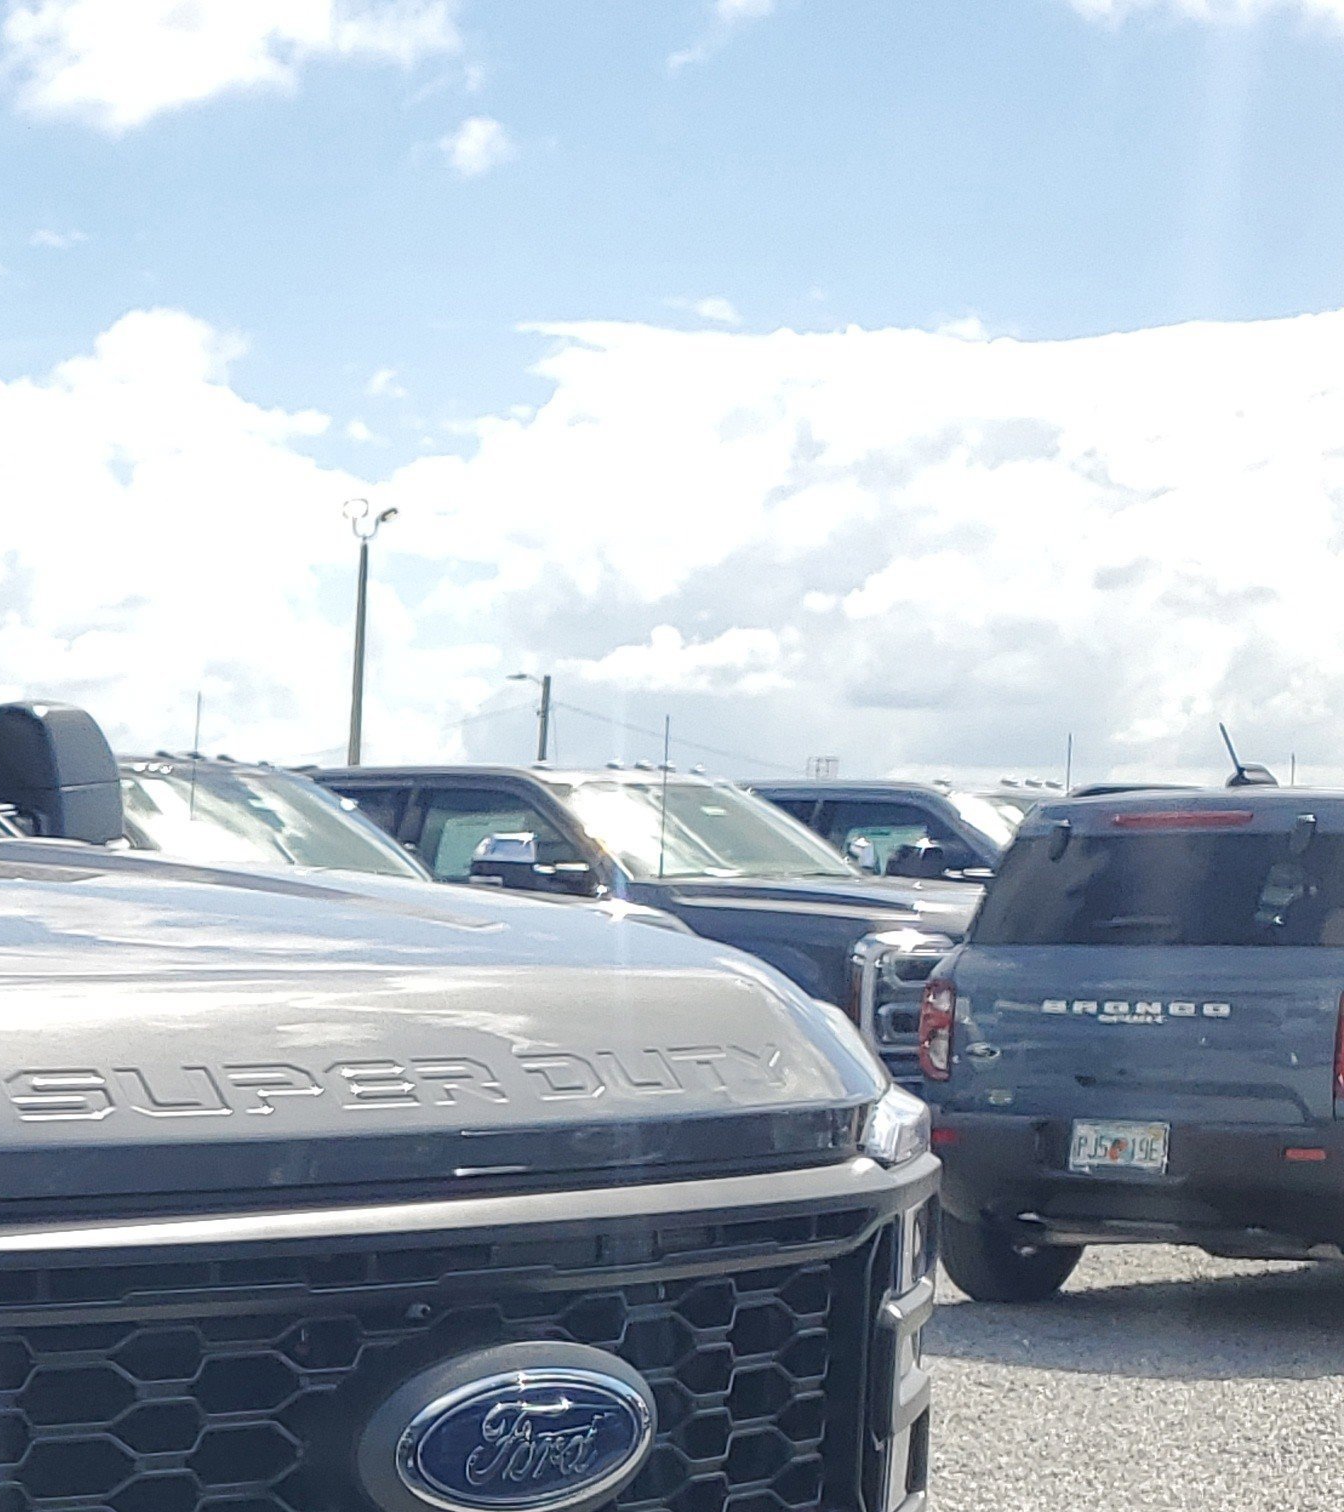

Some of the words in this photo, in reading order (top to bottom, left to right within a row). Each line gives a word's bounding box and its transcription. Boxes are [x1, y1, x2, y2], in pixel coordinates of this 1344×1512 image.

[1042, 999, 1231, 1018] BRONCO
[4, 1058, 509, 1123] SUPER
[515, 1044, 787, 1102] DUTY
[465, 1400, 624, 1485] Ford
